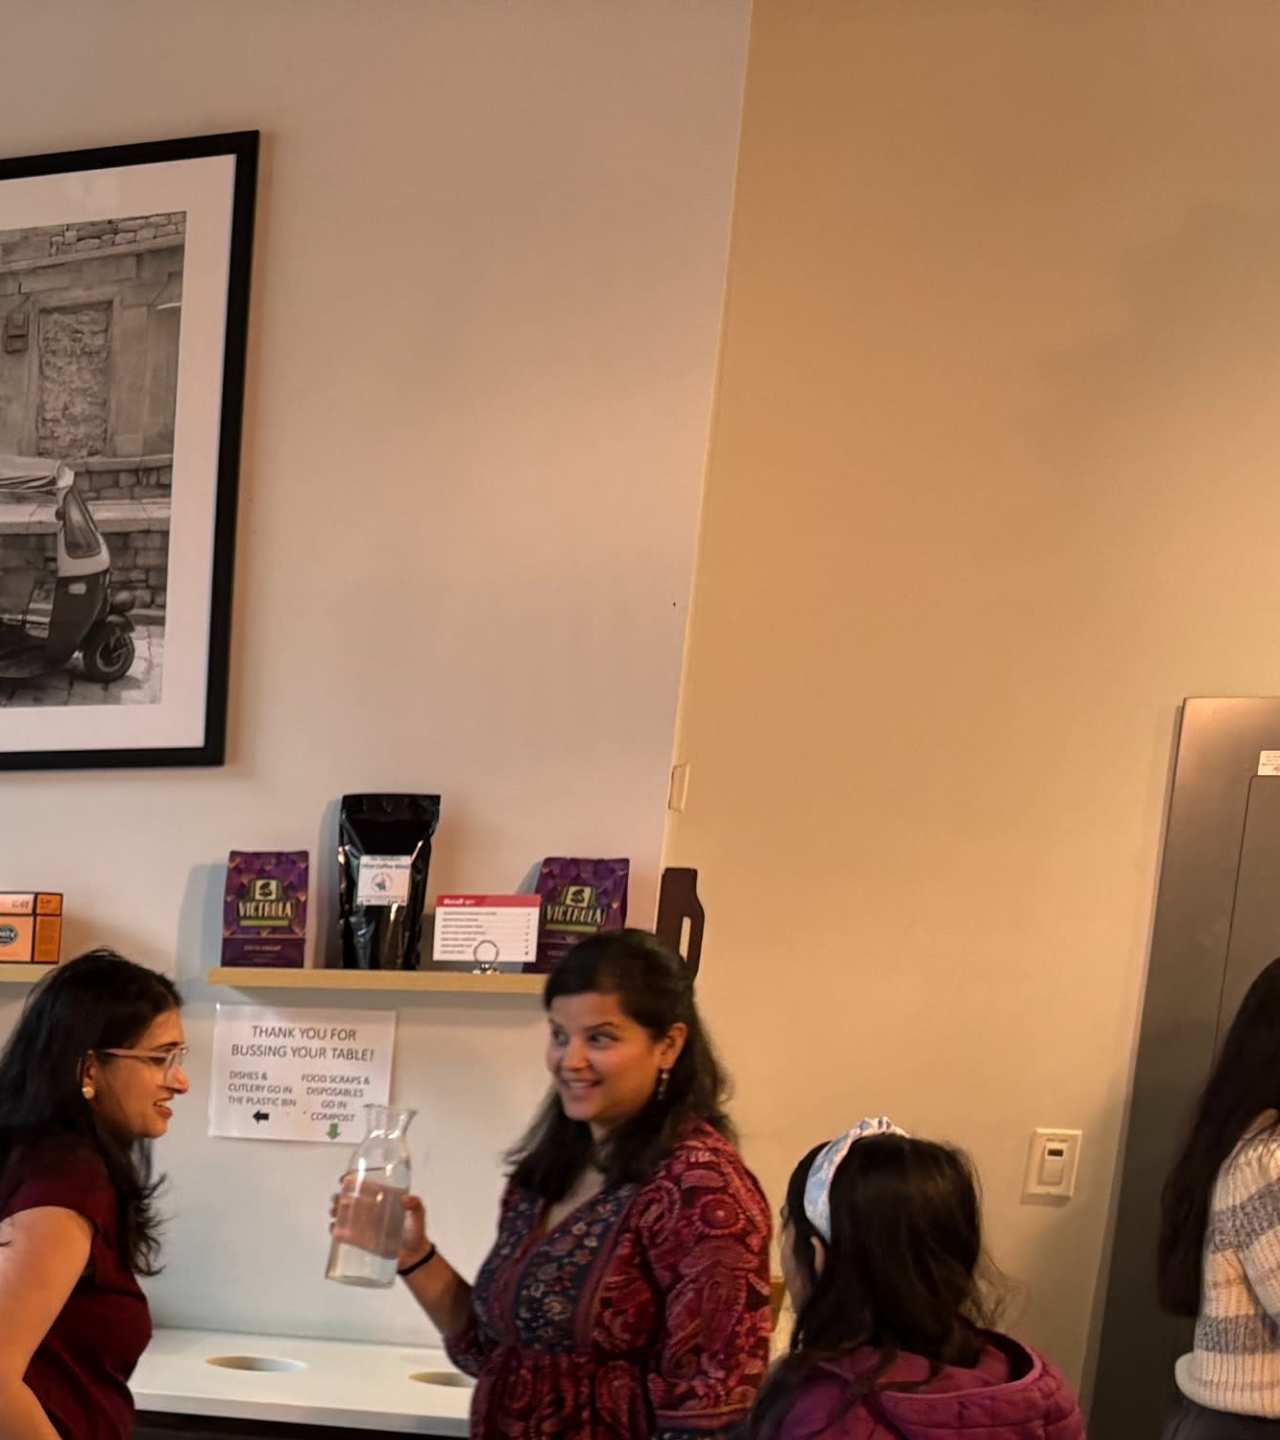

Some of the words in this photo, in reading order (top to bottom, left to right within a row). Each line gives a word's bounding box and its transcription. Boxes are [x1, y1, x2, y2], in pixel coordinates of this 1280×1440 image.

[252, 1025, 295, 1039] THANK
[299, 1027, 327, 1041] YOU
[330, 1028, 357, 1041] FOR
[231, 1044, 287, 1058] BUSSING
[290, 1047, 327, 1060] YOUR
[331, 1048, 374, 1062] TABLE!
[229, 1071, 259, 1080] DISHES
[301, 1073, 327, 1084] FOOD
[328, 1075, 361, 1085] SCRAPS
[228, 1083, 265, 1093] CUTLERY
[267, 1085, 280, 1094] GO
[282, 1085, 293, 1094] IN
[306, 1087, 363, 1098] DISPOSABLES
[228, 1096, 244, 1105] THE
[246, 1097, 278, 1106] PLASTIC
[321, 1100, 335, 1109] GO
[310, 1112, 355, 1122] COMPOST
